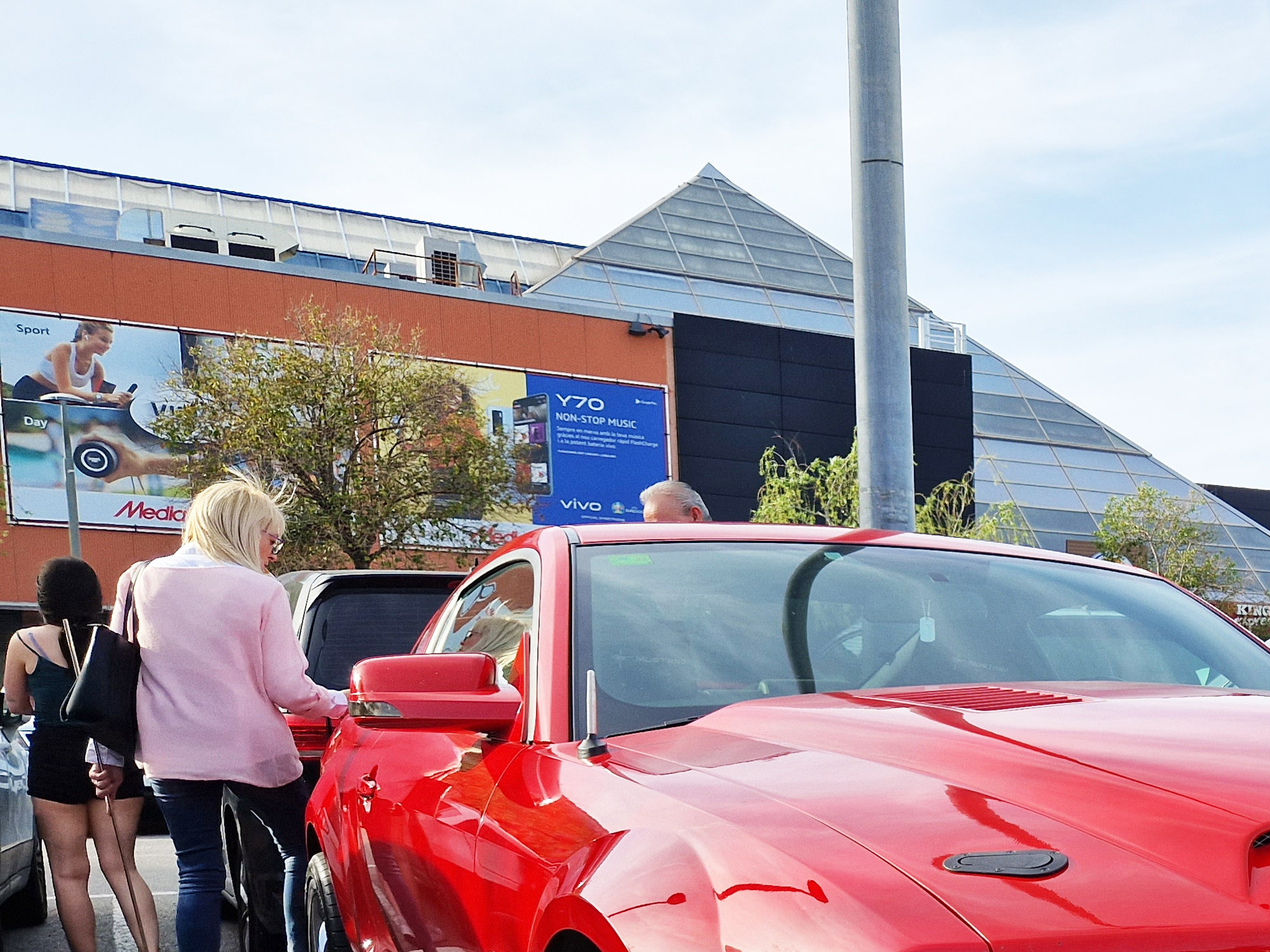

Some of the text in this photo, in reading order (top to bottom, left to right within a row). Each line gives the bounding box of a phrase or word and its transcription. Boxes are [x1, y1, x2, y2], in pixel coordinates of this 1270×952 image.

[16, 323, 50, 337] Sport
[555, 393, 605, 411] Y70
[24, 415, 48, 429] Day
[555, 412, 637, 429] NON-STOP MUSIC
[560, 497, 602, 512] vivo
